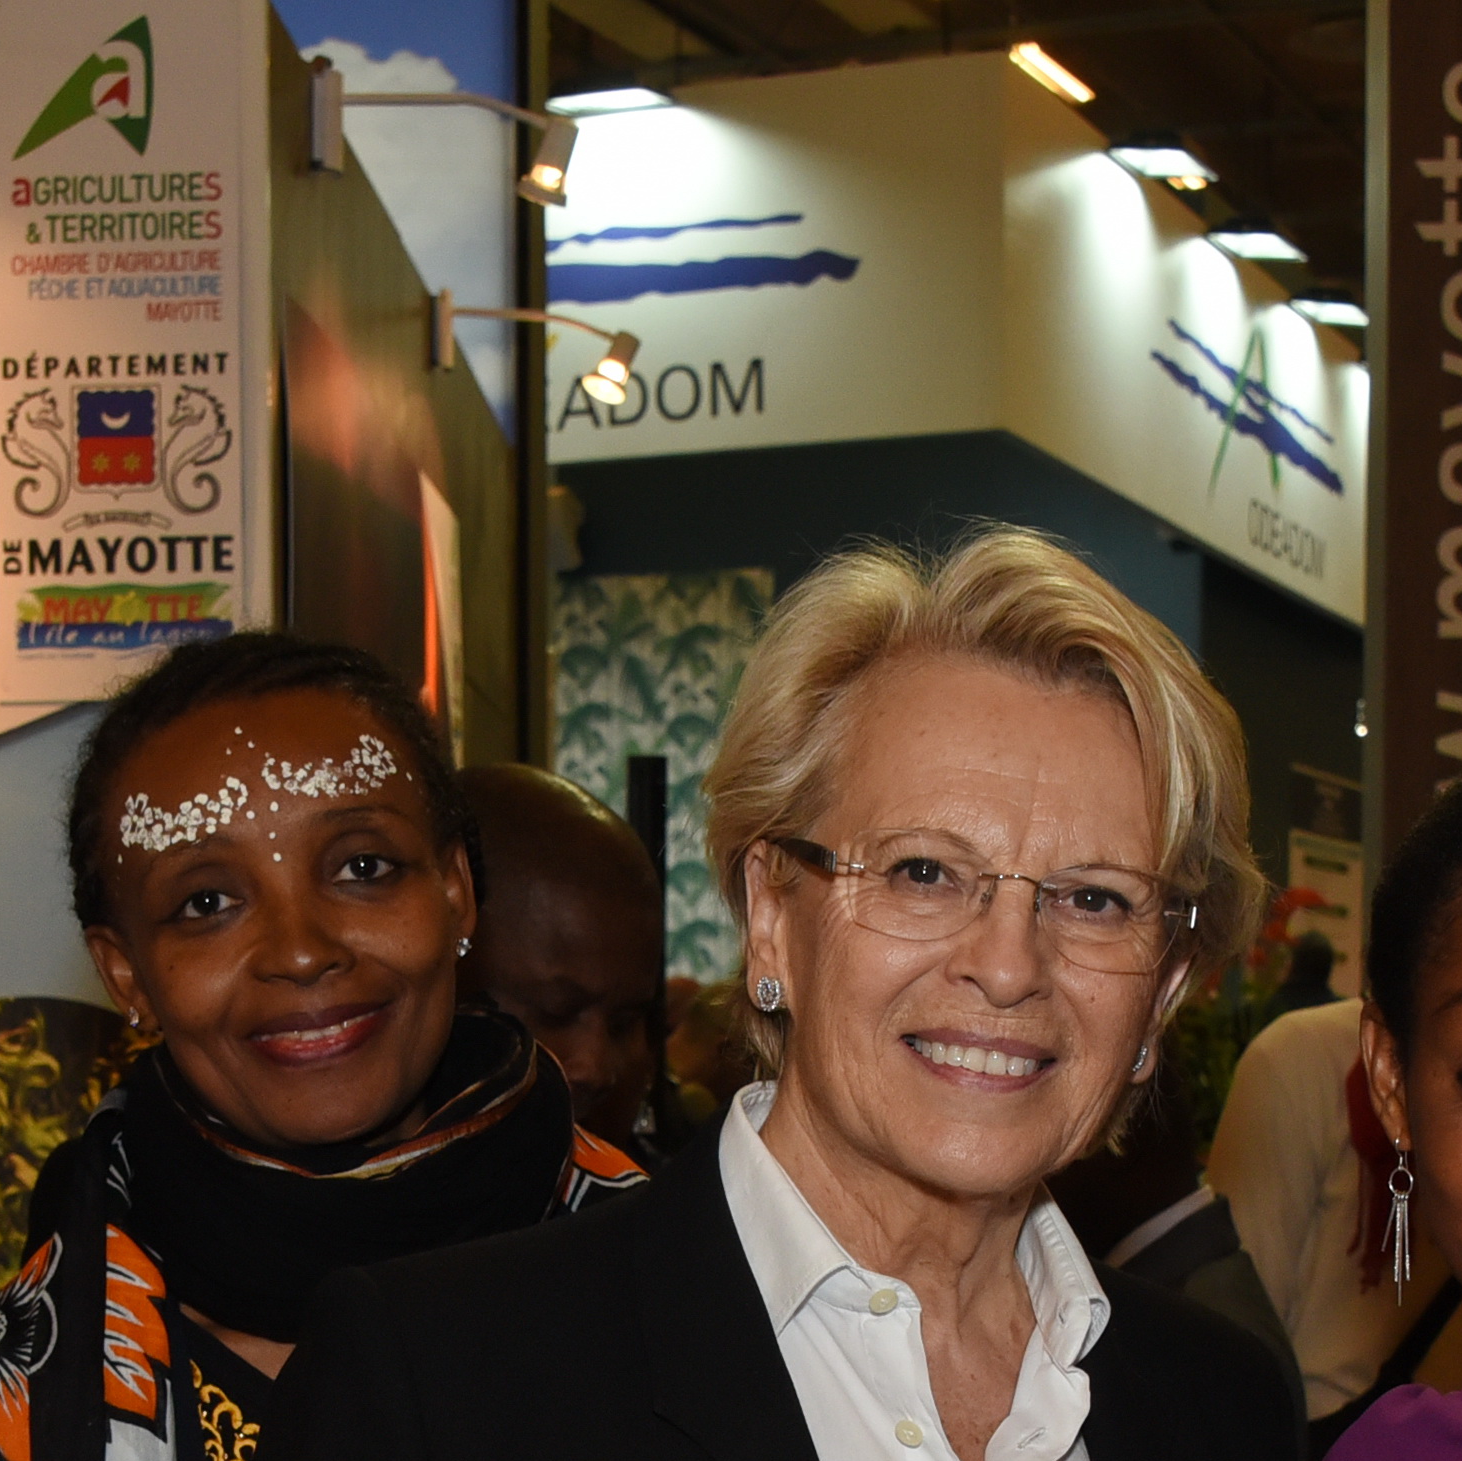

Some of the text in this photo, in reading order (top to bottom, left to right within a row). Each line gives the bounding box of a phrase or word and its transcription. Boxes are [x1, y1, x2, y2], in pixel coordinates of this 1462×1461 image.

[26, 210, 223, 244] & TERRITOIRES
[10, 250, 222, 276] CHAMBRE D'AGRICULTURE
[84, 277, 105, 298] ET
[107, 273, 222, 297] AQUACULTURE
[145, 300, 222, 323] MAYOTTE
[1, 351, 230, 380] DÉPARTEMENT
[3, 538, 22, 576] DE
[28, 535, 235, 576] MAYOTTE
